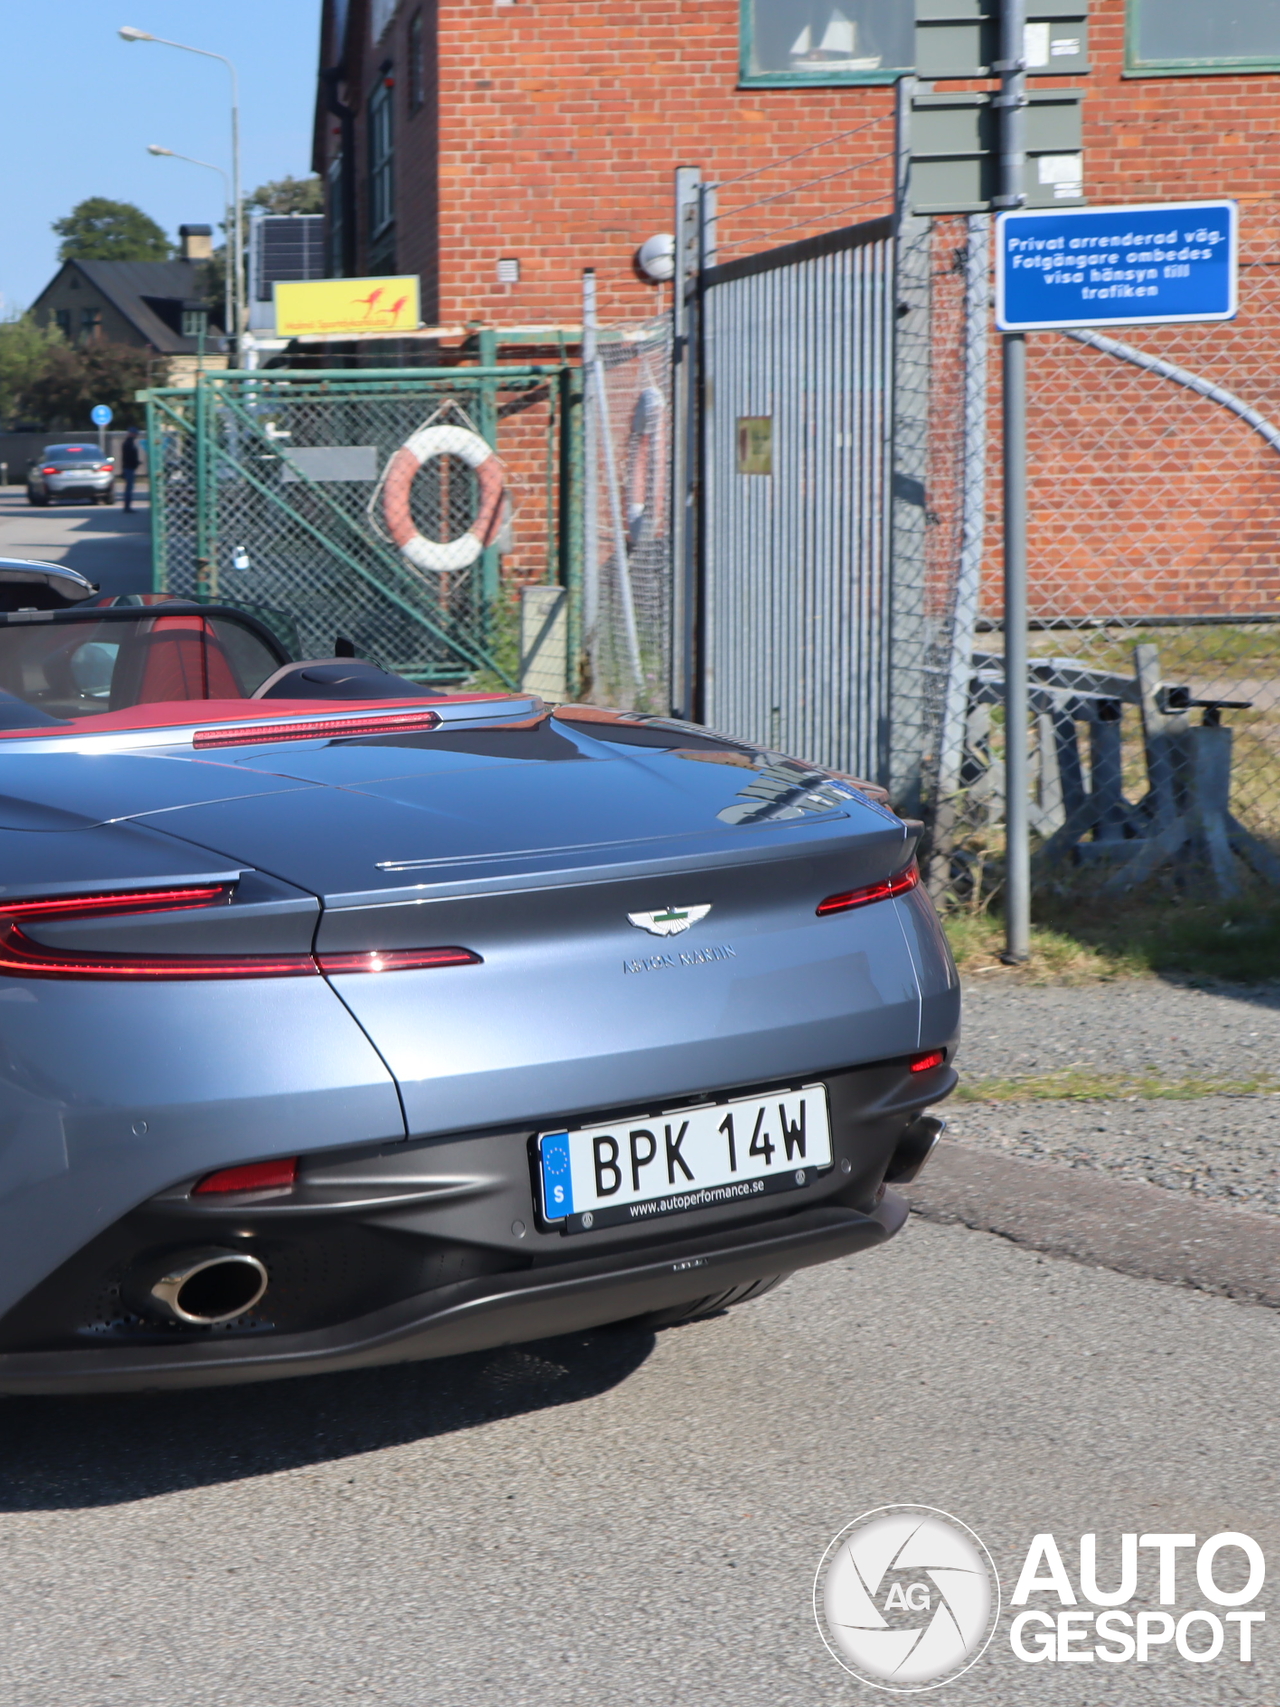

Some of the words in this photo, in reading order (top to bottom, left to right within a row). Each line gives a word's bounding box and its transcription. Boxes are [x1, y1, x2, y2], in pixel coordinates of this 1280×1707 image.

[1008, 236, 1065, 252] Privat
[1069, 230, 1178, 249] arrenderad
[1183, 228, 1226, 245] väg.
[1012, 252, 1120, 271] Fotgängare
[1125, 247, 1213, 264] ombedes
[1043, 270, 1084, 285] visa
[1090, 267, 1158, 283] hänsyn
[1163, 263, 1191, 279] till
[1081, 284, 1159, 300] trafiken
[623, 953, 676, 974] ASTON
[678, 944, 737, 966] MARTIN
[592, 1120, 695, 1198] BPK
[716, 1099, 807, 1172] 14W
[553, 1185, 564, 1203] S
[629, 1178, 765, 1218] www.autoperformance.se
